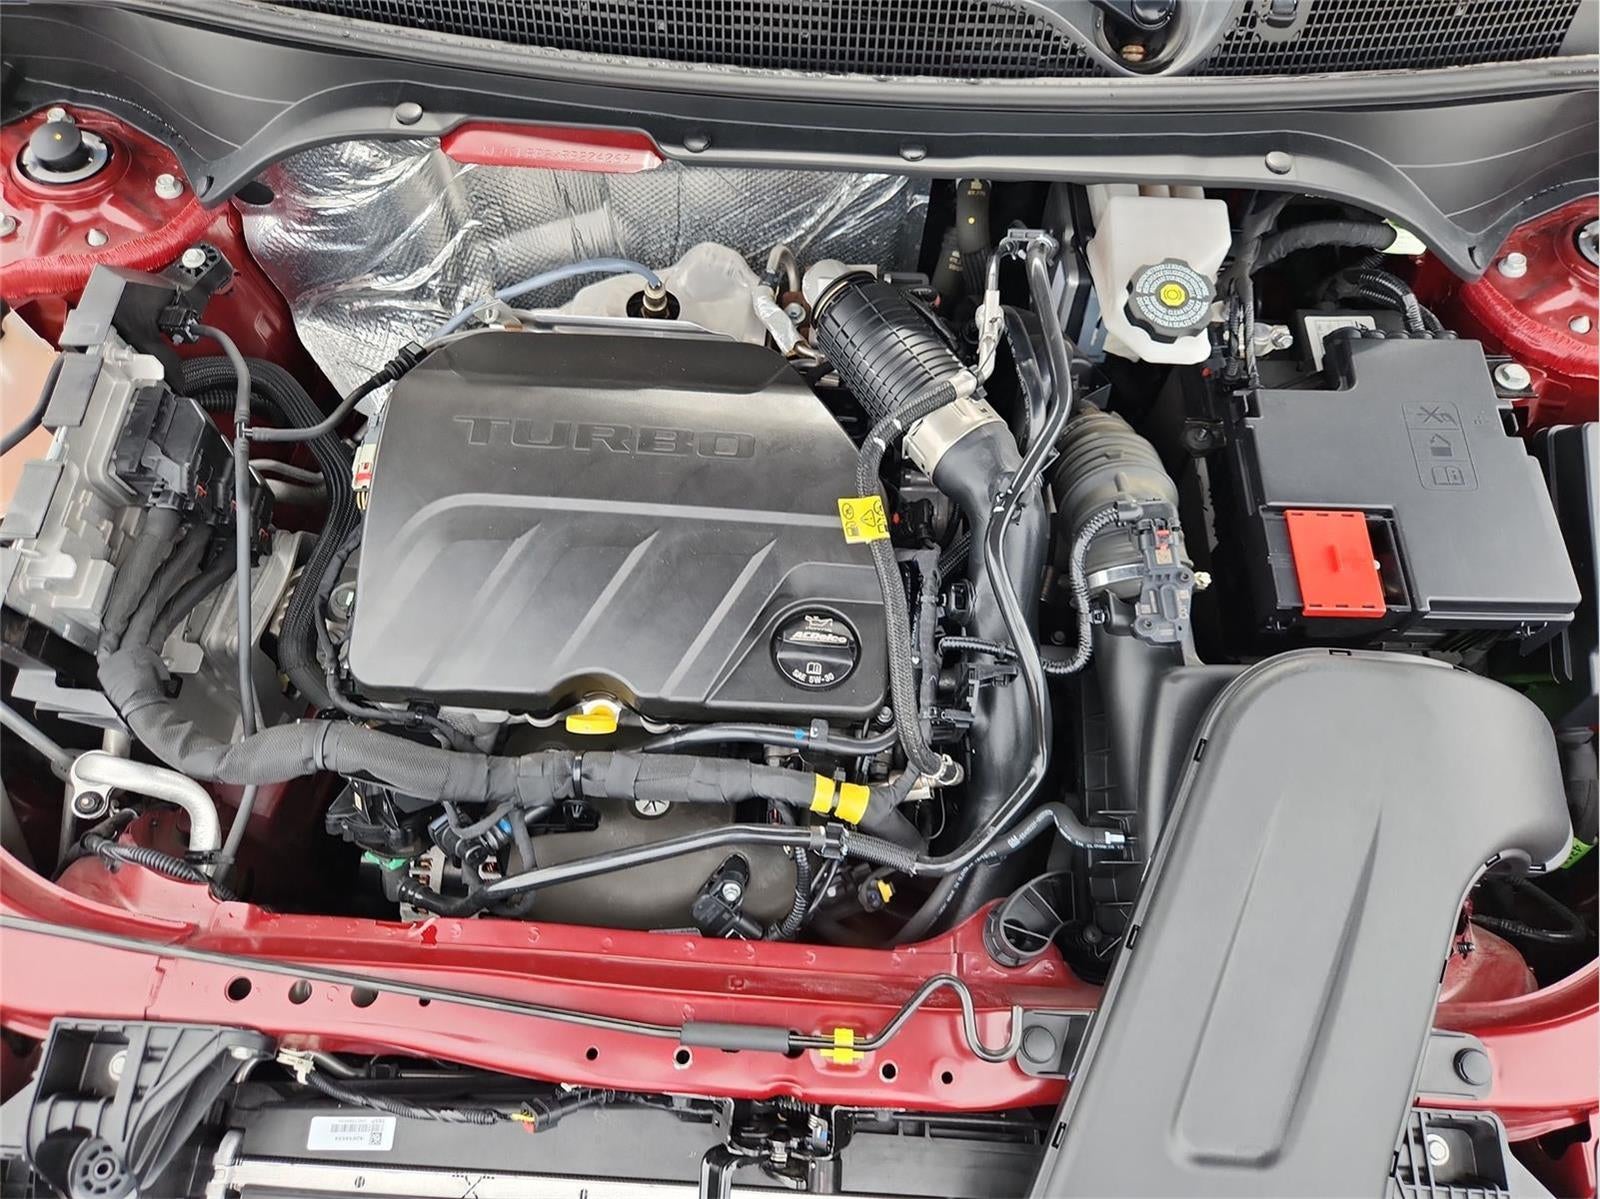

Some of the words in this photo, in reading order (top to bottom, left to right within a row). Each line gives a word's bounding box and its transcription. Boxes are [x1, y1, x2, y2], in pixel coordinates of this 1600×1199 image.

[453, 415, 757, 460] TURBO
[790, 631, 847, 643] ACDelco
[793, 669, 806, 682] SAE
